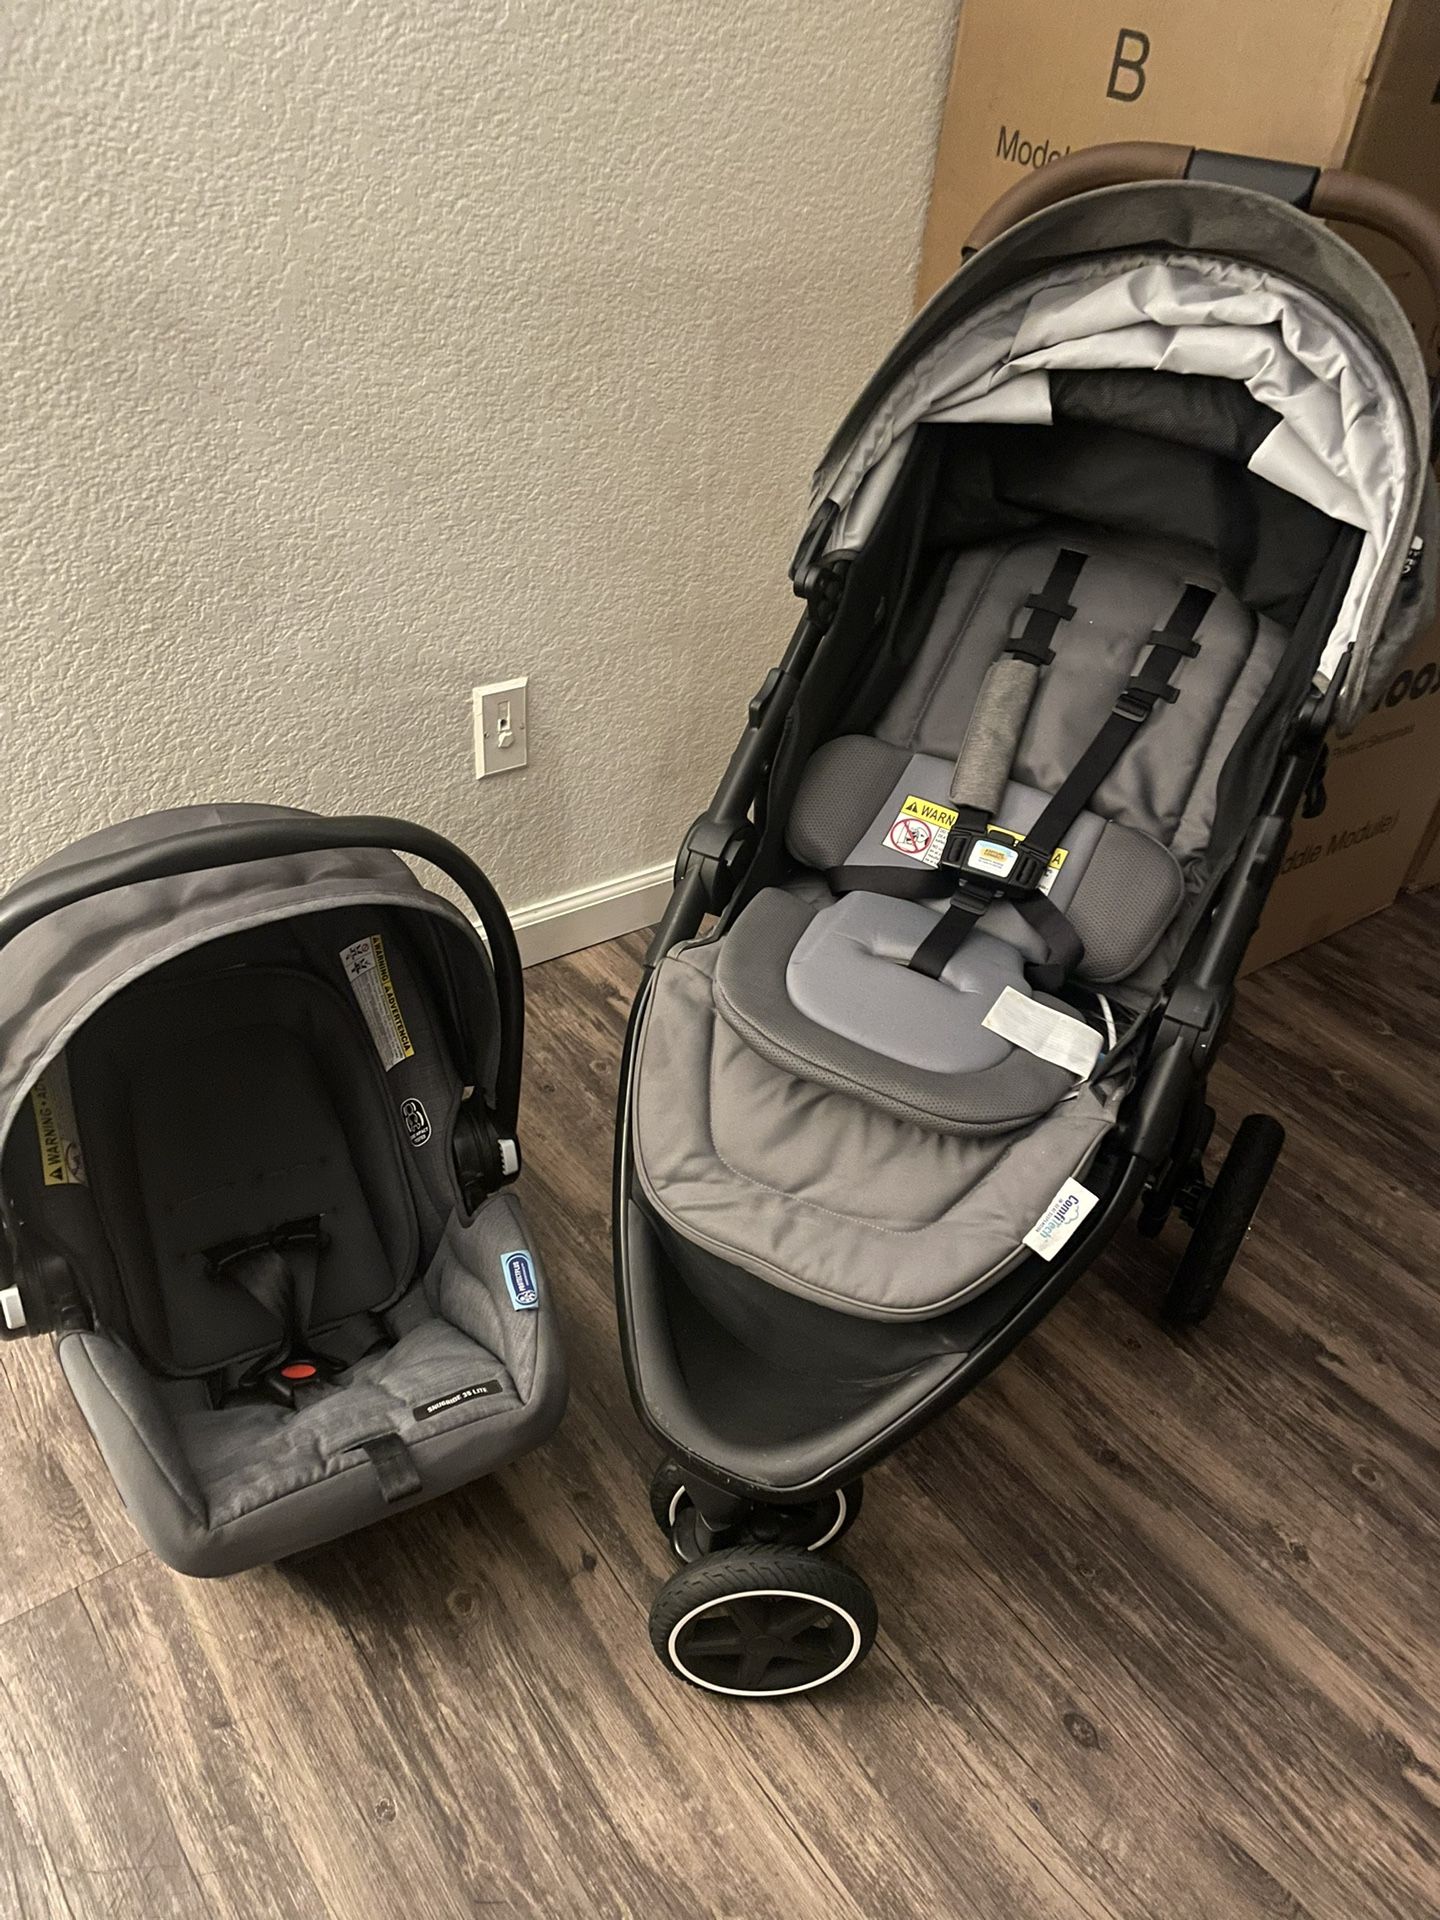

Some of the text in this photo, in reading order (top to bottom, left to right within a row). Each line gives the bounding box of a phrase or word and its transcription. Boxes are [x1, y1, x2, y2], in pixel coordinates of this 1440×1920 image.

[1106, 27, 1151, 102] B
[996, 125, 1070, 169] Mod
[374, 943, 411, 1052] WARNING ADVERTENCIA
[41, 1106, 63, 1167] WARNING
[1040, 1194, 1080, 1238] ComfiTech
